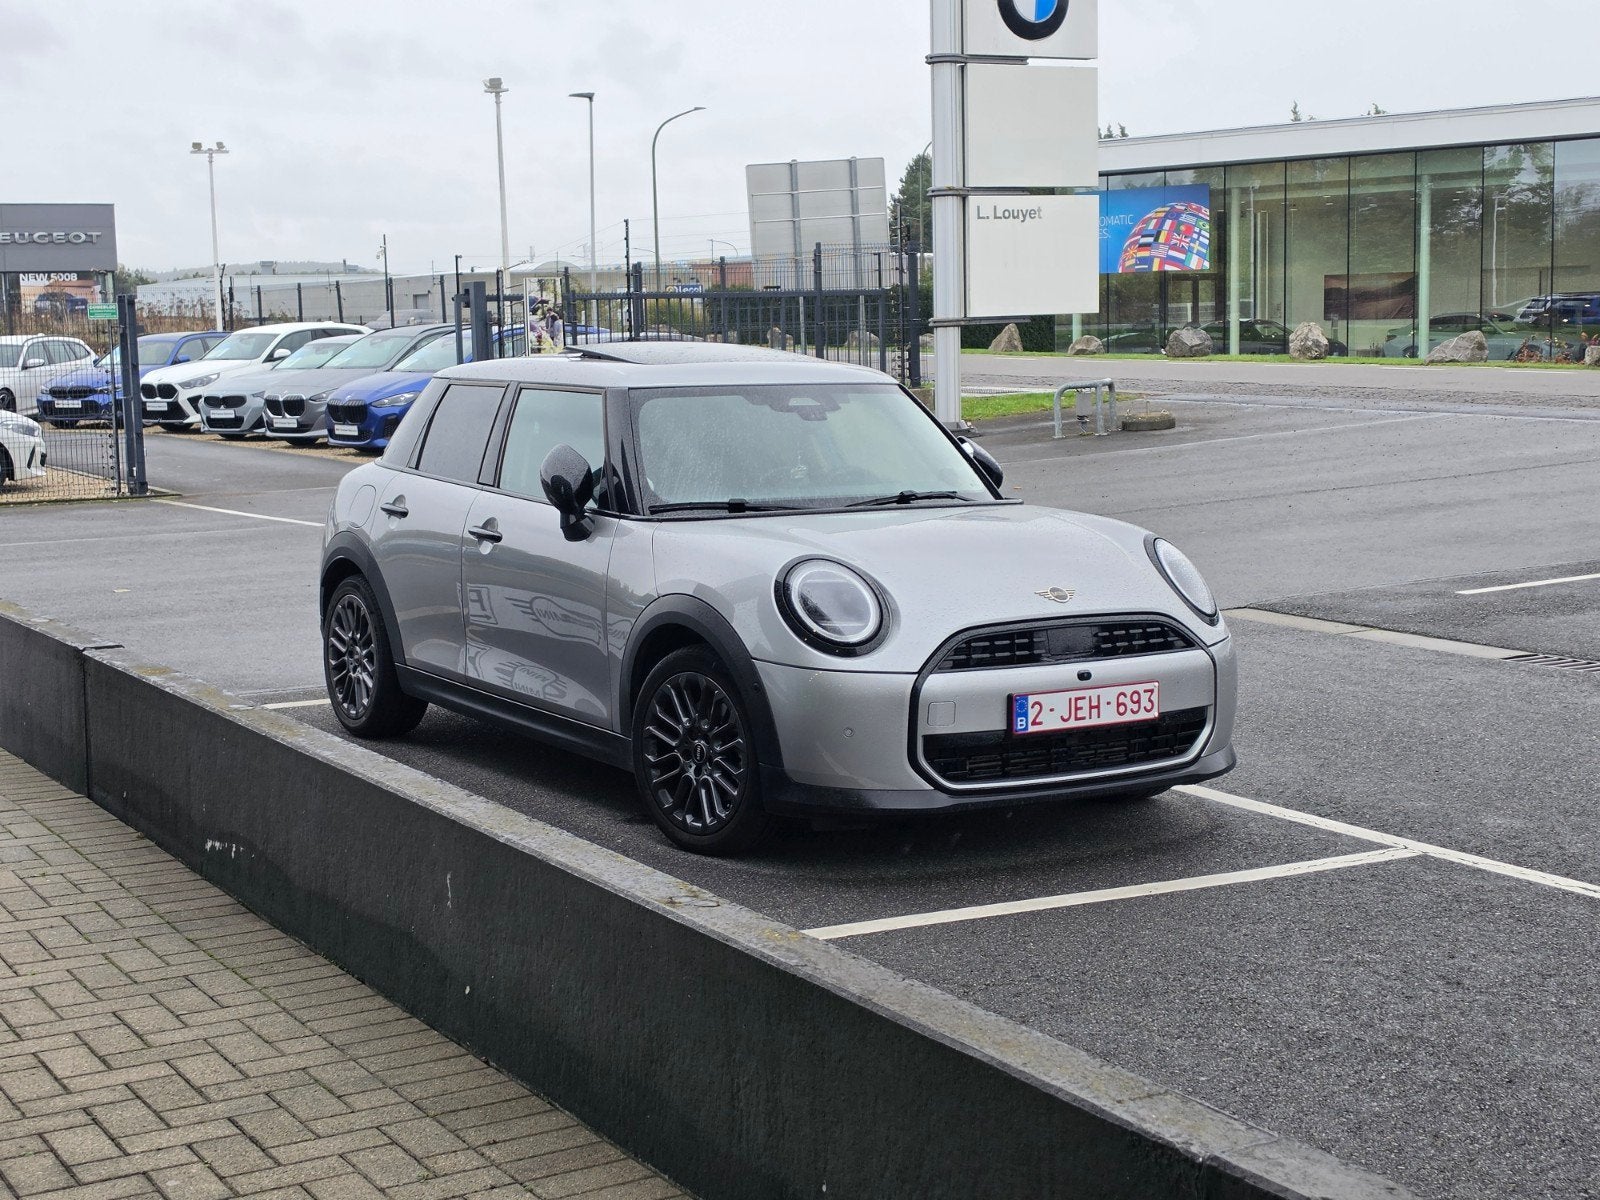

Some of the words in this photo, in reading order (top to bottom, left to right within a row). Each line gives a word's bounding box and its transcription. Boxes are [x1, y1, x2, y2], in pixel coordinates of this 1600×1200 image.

[976, 205, 989, 220] L.
[993, 205, 1043, 224] Louyet
[20, 273, 48, 282] NEW
[50, 272, 78, 282] 5008
[1017, 716, 1027, 730] B
